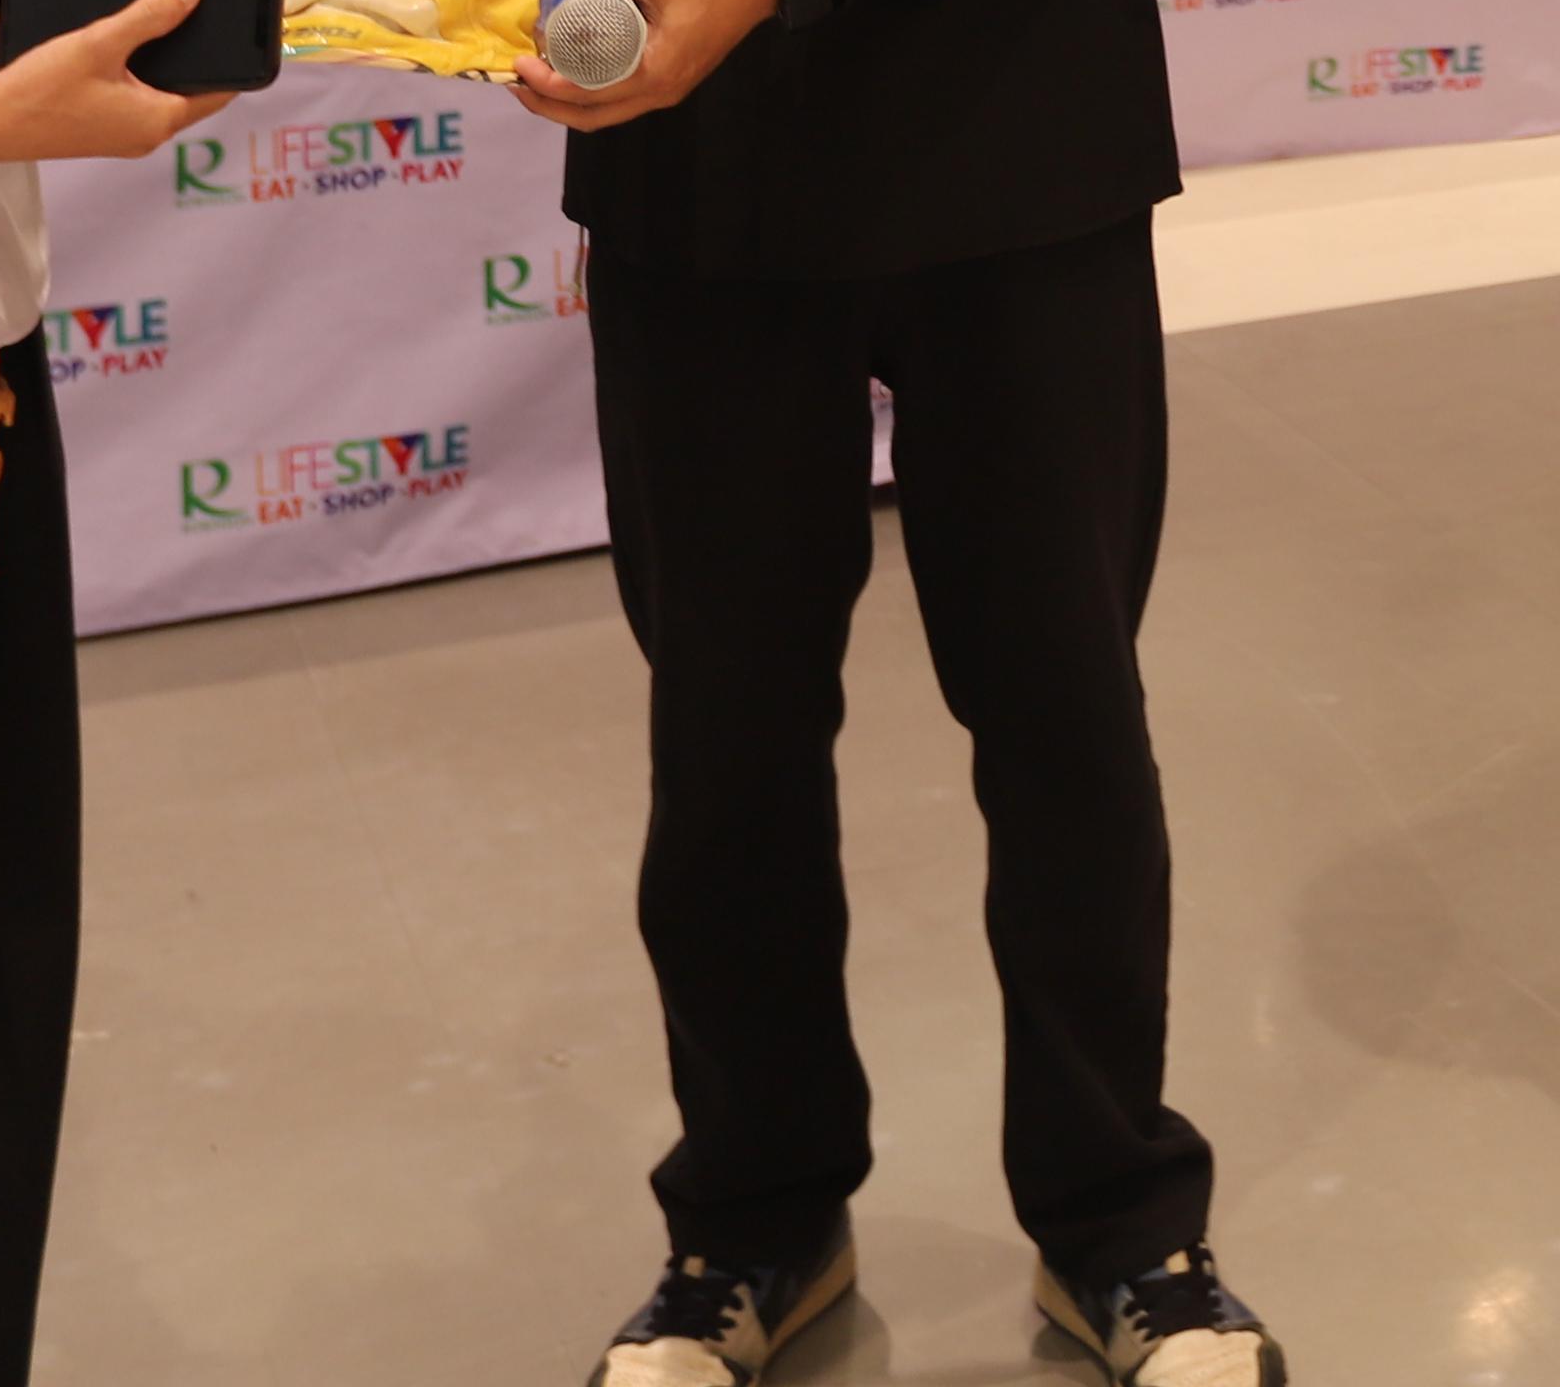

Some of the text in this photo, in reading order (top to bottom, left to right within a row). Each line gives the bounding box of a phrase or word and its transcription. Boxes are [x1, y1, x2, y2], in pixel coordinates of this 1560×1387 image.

[247, 112, 463, 175] LIFESTYLE
[250, 175, 297, 203] EAT
[314, 166, 388, 196] SHOP
[401, 158, 465, 185] PLAY
[103, 346, 169, 377] PLAY
[254, 423, 469, 497] LIFESTYLE
[256, 496, 304, 525] EAT
[322, 483, 394, 516] SHOP
[406, 469, 469, 499] PLAY
